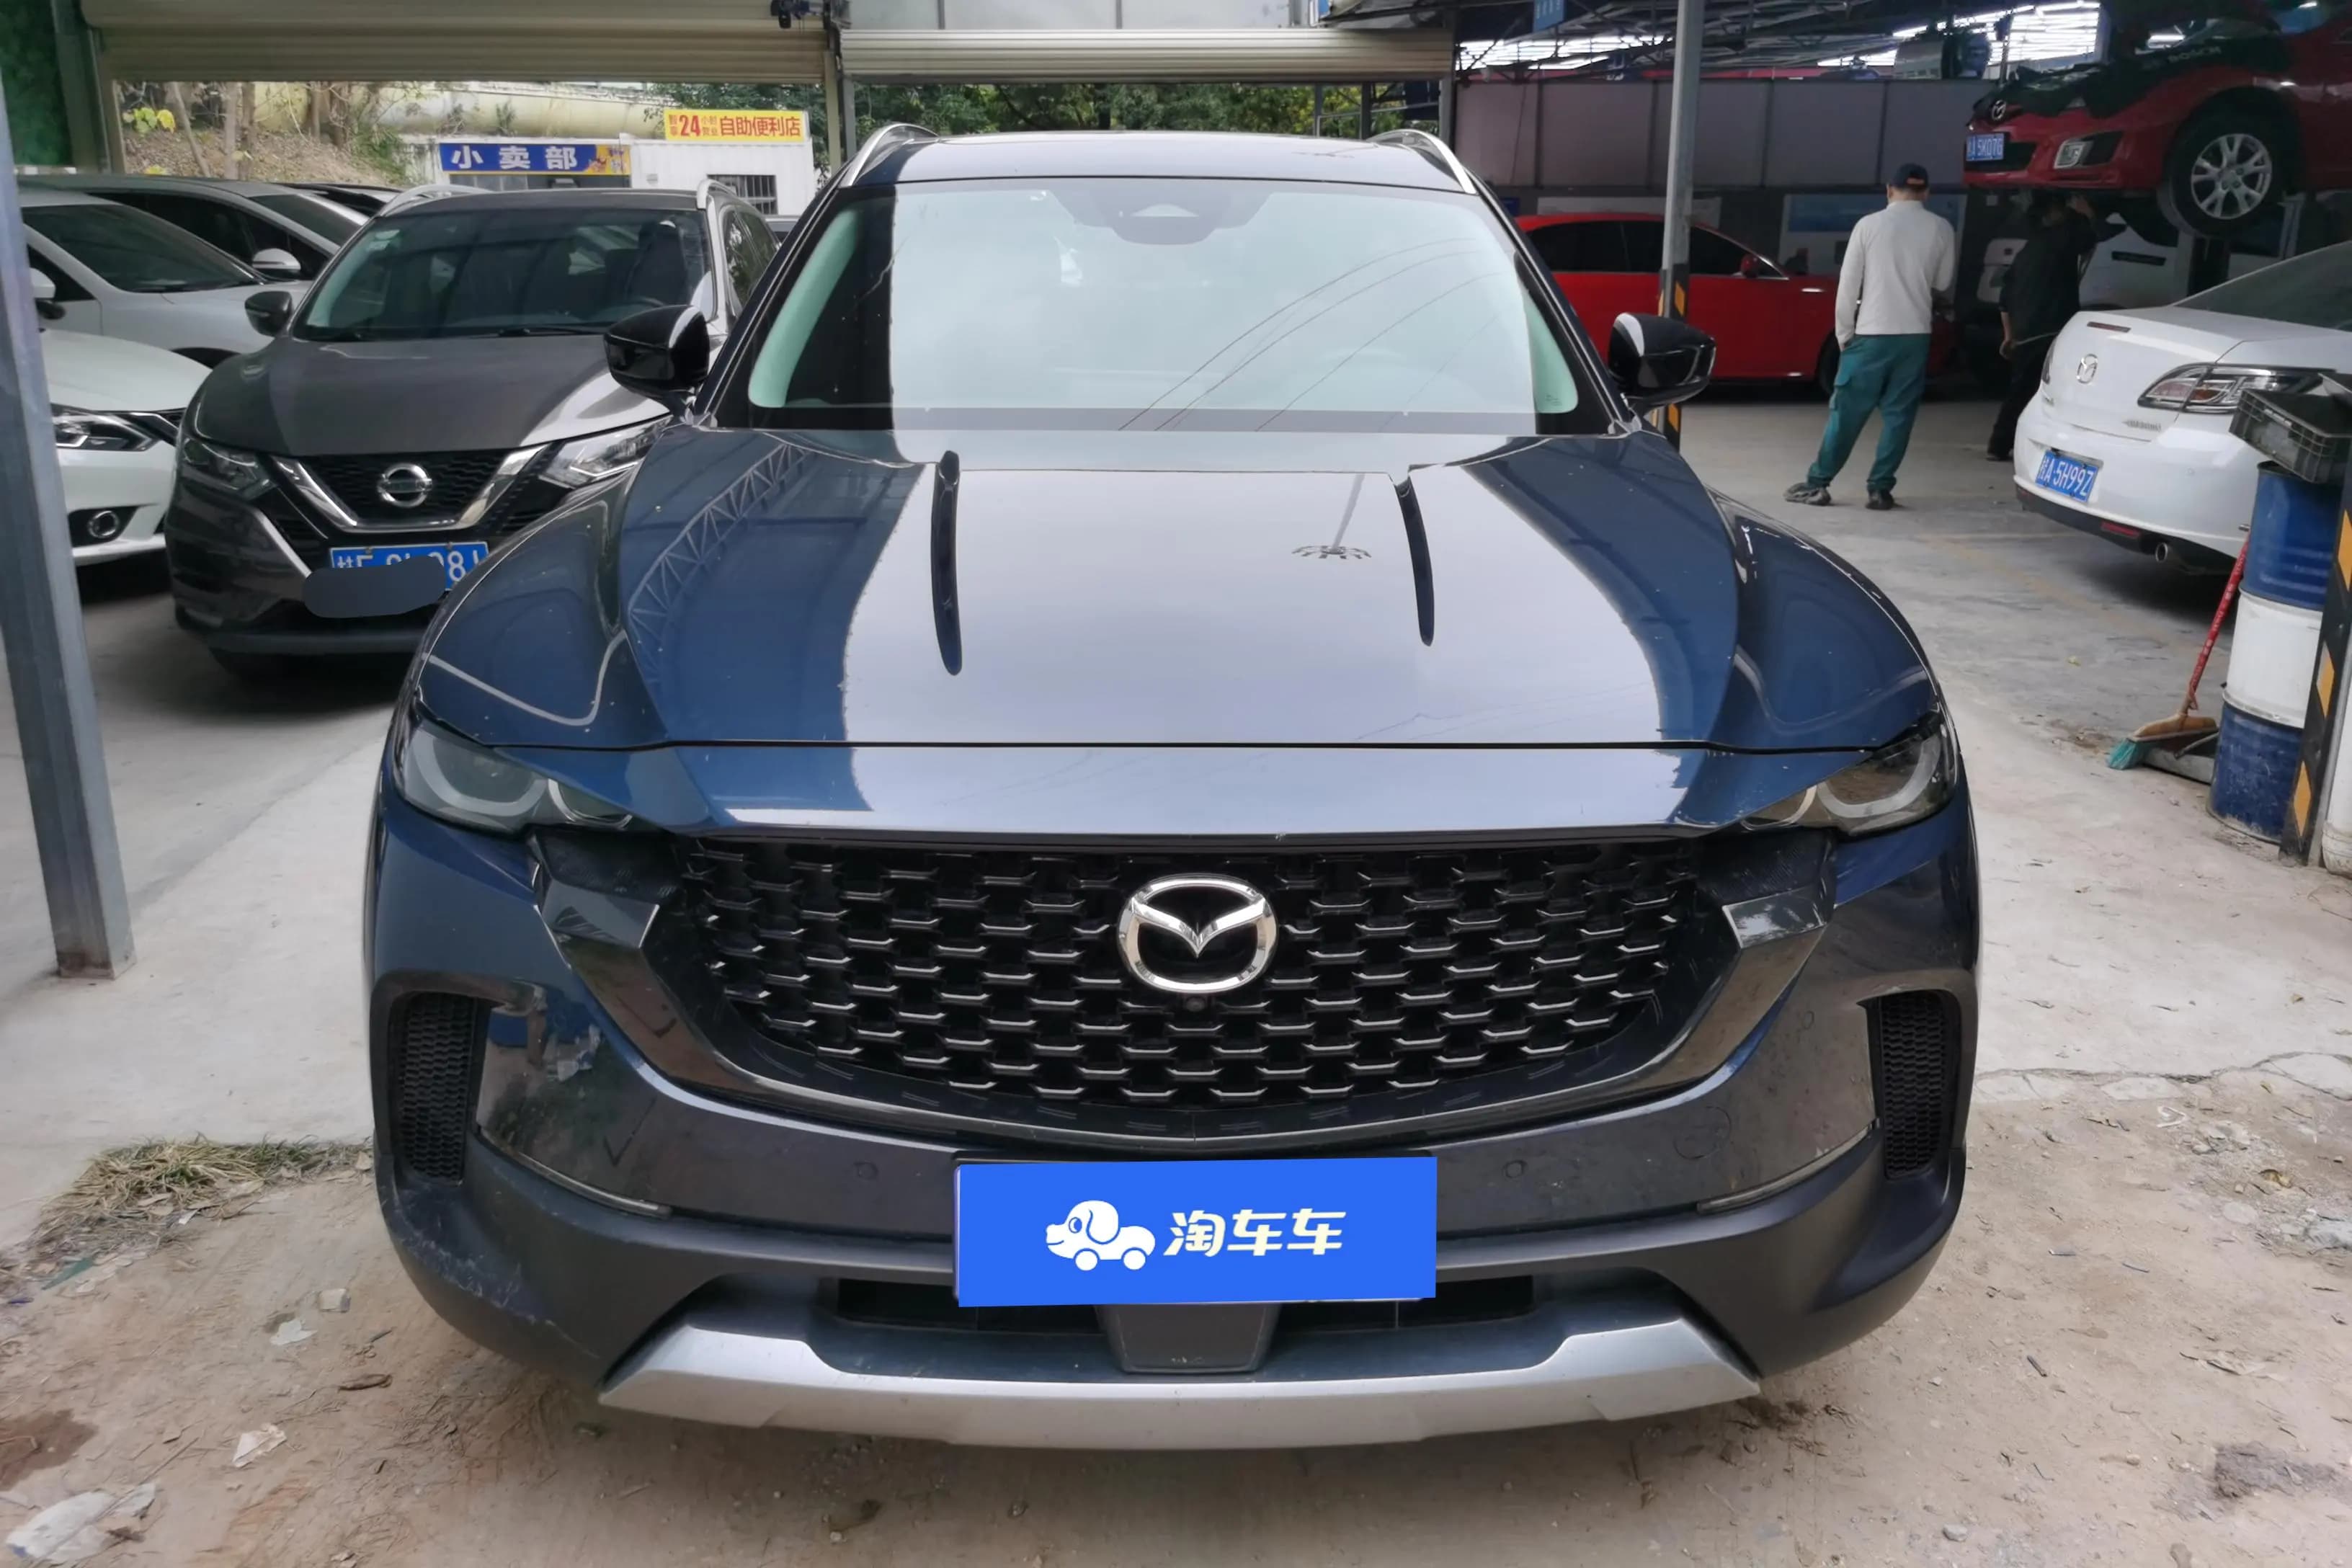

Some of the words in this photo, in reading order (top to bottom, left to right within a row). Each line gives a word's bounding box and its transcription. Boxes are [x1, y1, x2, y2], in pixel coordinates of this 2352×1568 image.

[679, 115, 700, 136] 24
[720, 116, 801, 136] 自助便利店
[451, 145, 578, 170] 小卖部
